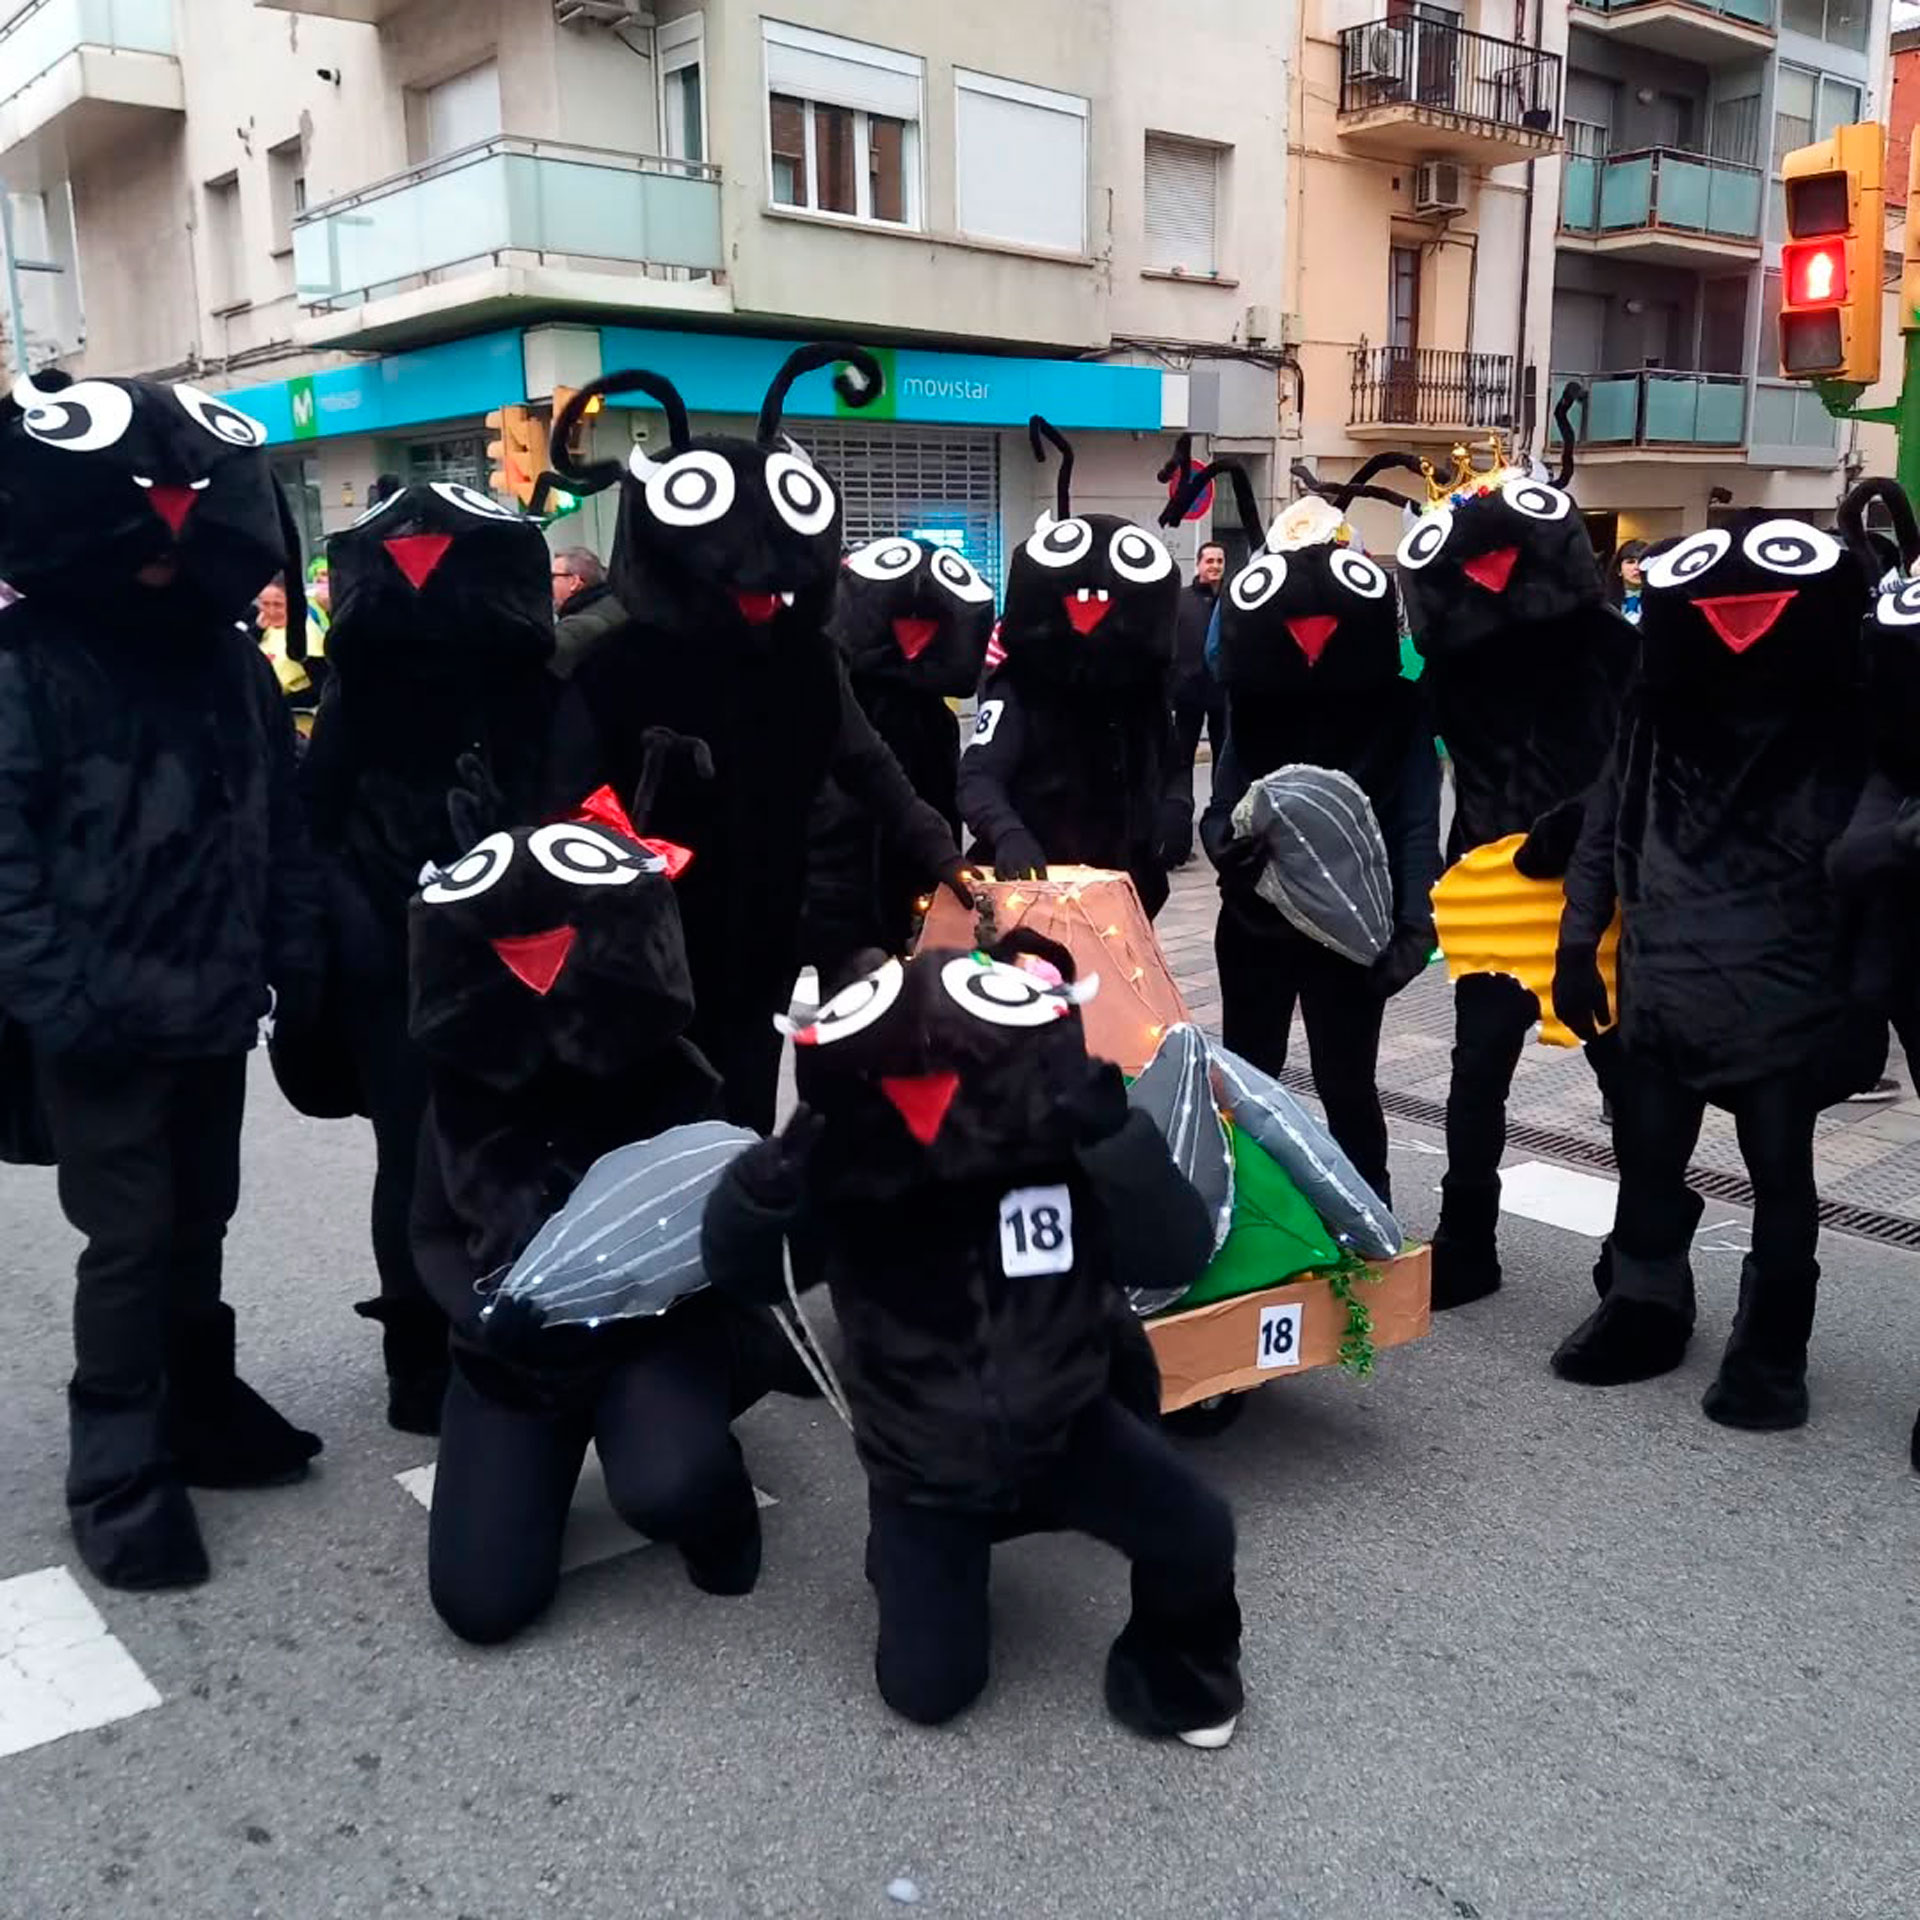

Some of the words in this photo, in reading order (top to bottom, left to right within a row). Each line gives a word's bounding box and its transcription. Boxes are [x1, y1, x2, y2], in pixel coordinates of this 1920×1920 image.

[903, 377, 991, 399] movistar
[975, 709, 993, 735] 8
[1005, 1205, 1064, 1254] 18
[1262, 1317, 1294, 1356] 18
